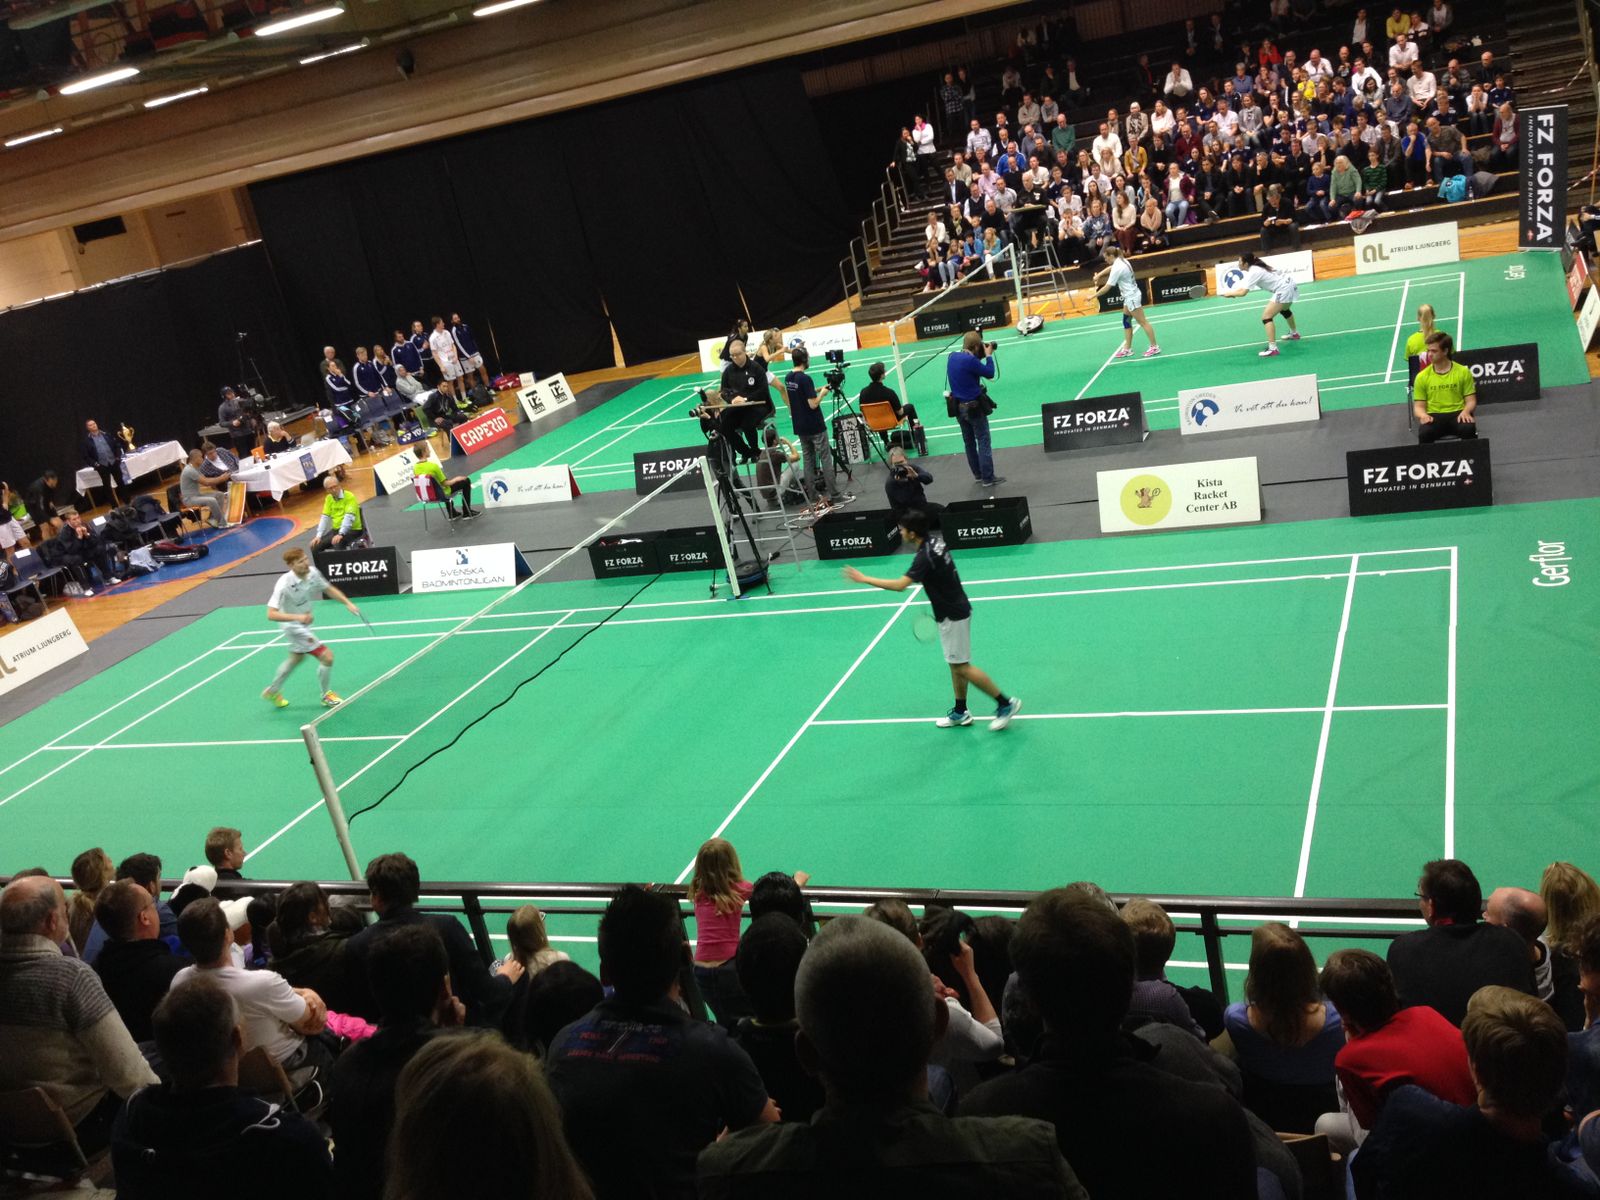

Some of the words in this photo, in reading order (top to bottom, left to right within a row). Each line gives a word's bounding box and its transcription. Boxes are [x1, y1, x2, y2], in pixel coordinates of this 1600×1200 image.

[1537, 113, 1554, 145] FZ
[1527, 168, 1534, 178] IN
[1536, 153, 1554, 241] FORZA
[1389, 245, 1414, 254] ATRIUM
[1415, 239, 1452, 250] LJUNGBERG
[1161, 288, 1170, 296] FZ
[1170, 286, 1191, 294] FORZA
[1465, 359, 1525, 378] ORZA
[1053, 414, 1072, 429] FZ
[1075, 407, 1130, 426] FORZA
[460, 415, 508, 447] CAPERIO
[642, 462, 657, 475] FZ
[1363, 467, 1389, 485] FZ
[1396, 459, 1473, 482] FORZA
[1197, 478, 1223, 488] Kista
[1364, 484, 1406, 494] INNOVATED
[1420, 480, 1457, 489] DENMARK
[1194, 490, 1228, 501] Racket
[1186, 503, 1220, 514] Center
[1221, 500, 1238, 511] AB
[957, 528, 969, 537] FZ
[970, 526, 1003, 536] FORZA
[830, 538, 841, 548] FZ
[842, 536, 872, 547] FORZA
[604, 559, 615, 567] FZ
[616, 556, 644, 566] FORZA
[669, 554, 679, 562] FZ
[680, 551, 708, 561] FORZA
[1528, 540, 1573, 587] Gerflor
[328, 563, 343, 576] FZ
[345, 559, 388, 575] FORZA
[440, 567, 485, 577] SVENSKA
[12, 646, 36, 663] ATRIUM
[36, 628, 72, 650] LJUNGBERG
